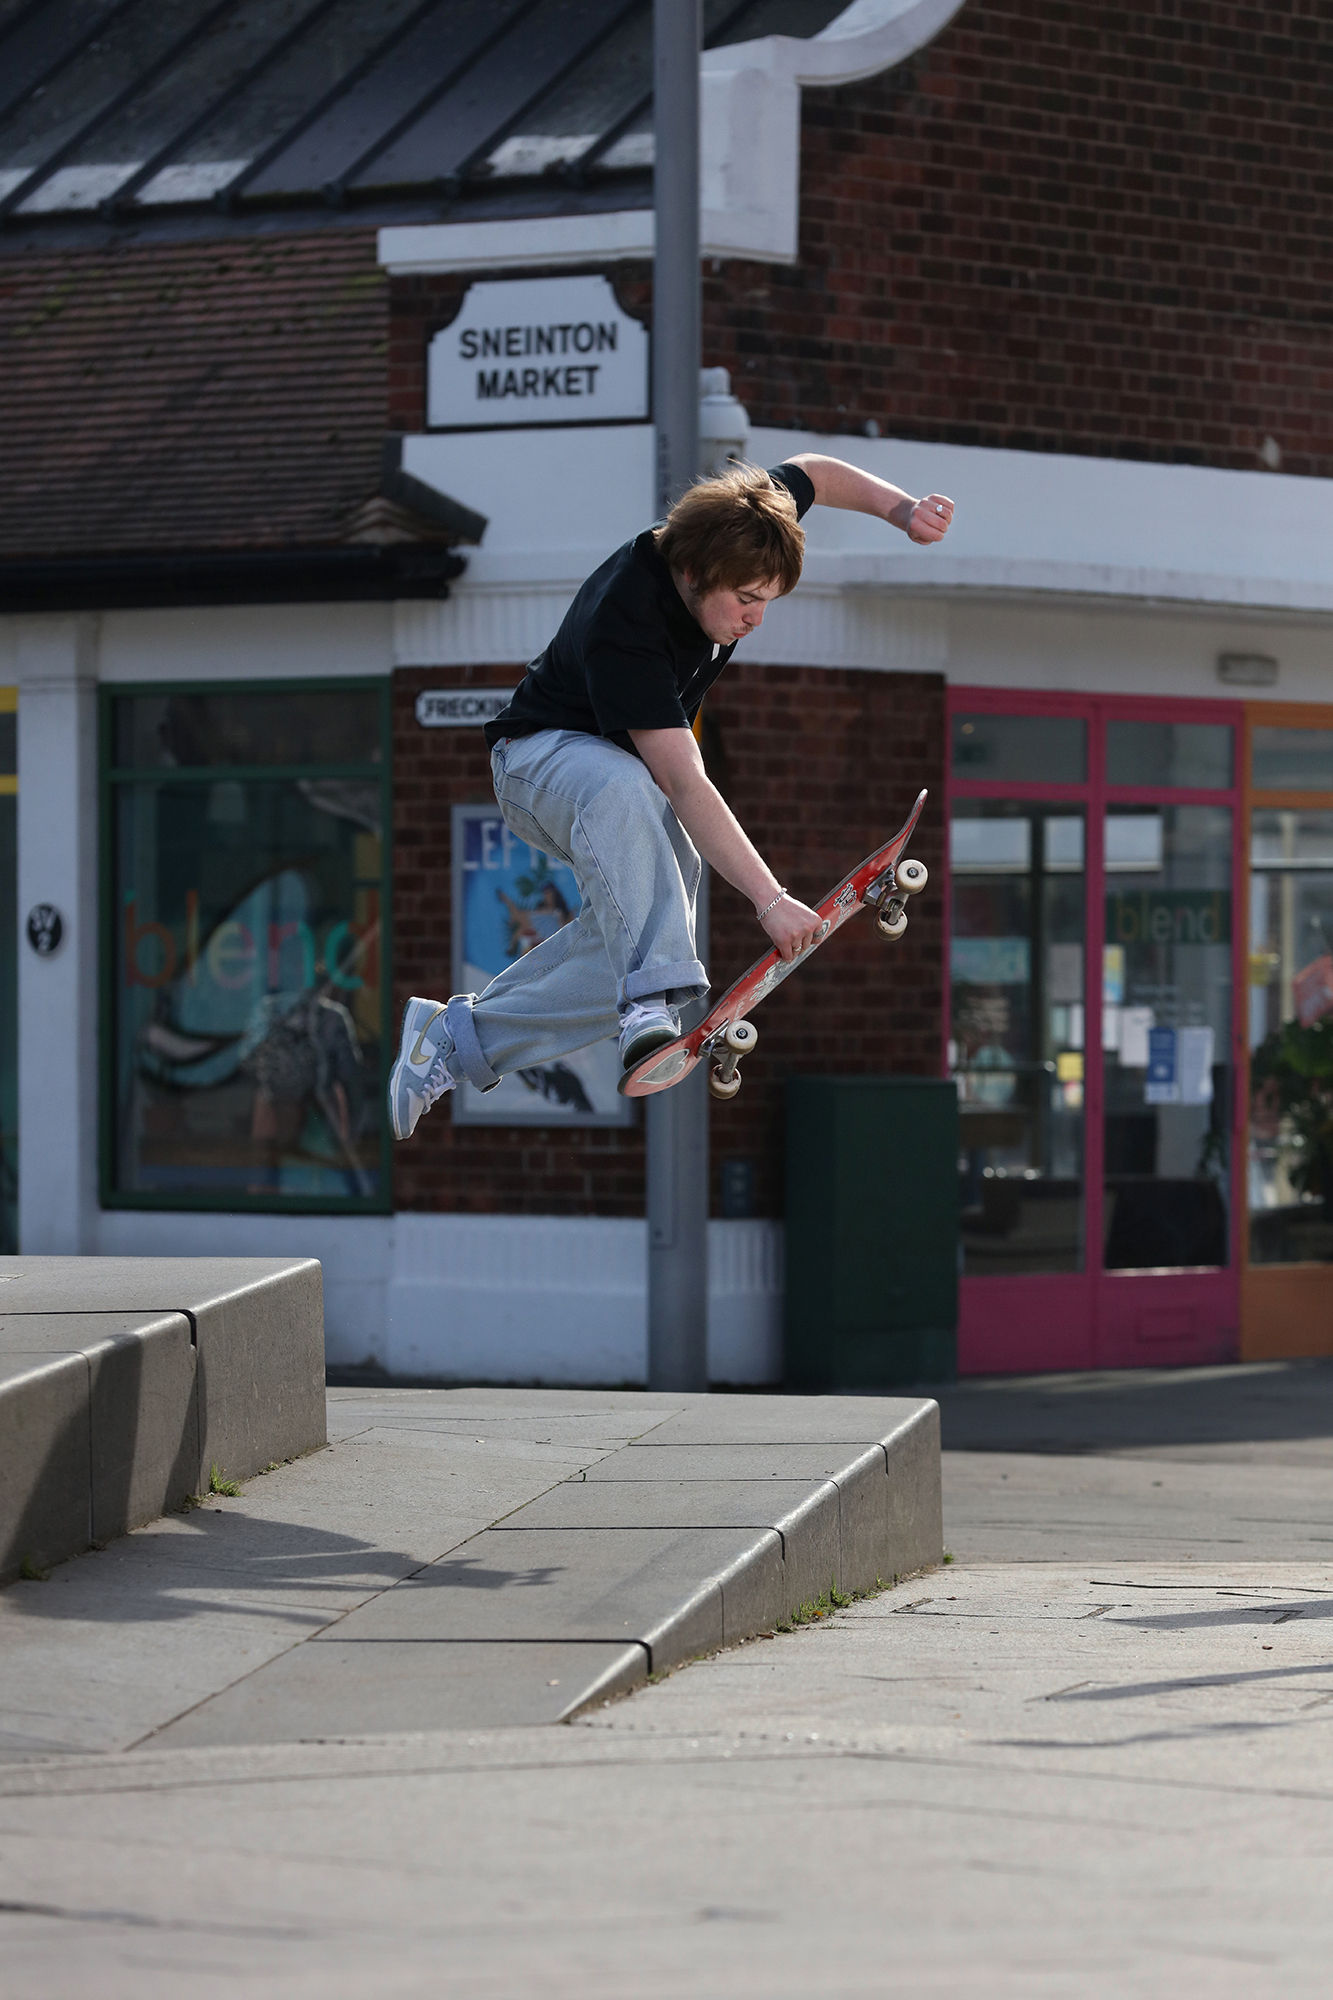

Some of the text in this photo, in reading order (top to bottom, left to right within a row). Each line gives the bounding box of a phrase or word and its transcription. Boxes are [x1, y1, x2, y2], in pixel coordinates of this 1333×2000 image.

[459, 321, 618, 360] SNEINTON
[477, 363, 600, 401] MARKET
[1115, 889, 1221, 942] blend
[124, 889, 380, 990] blend
